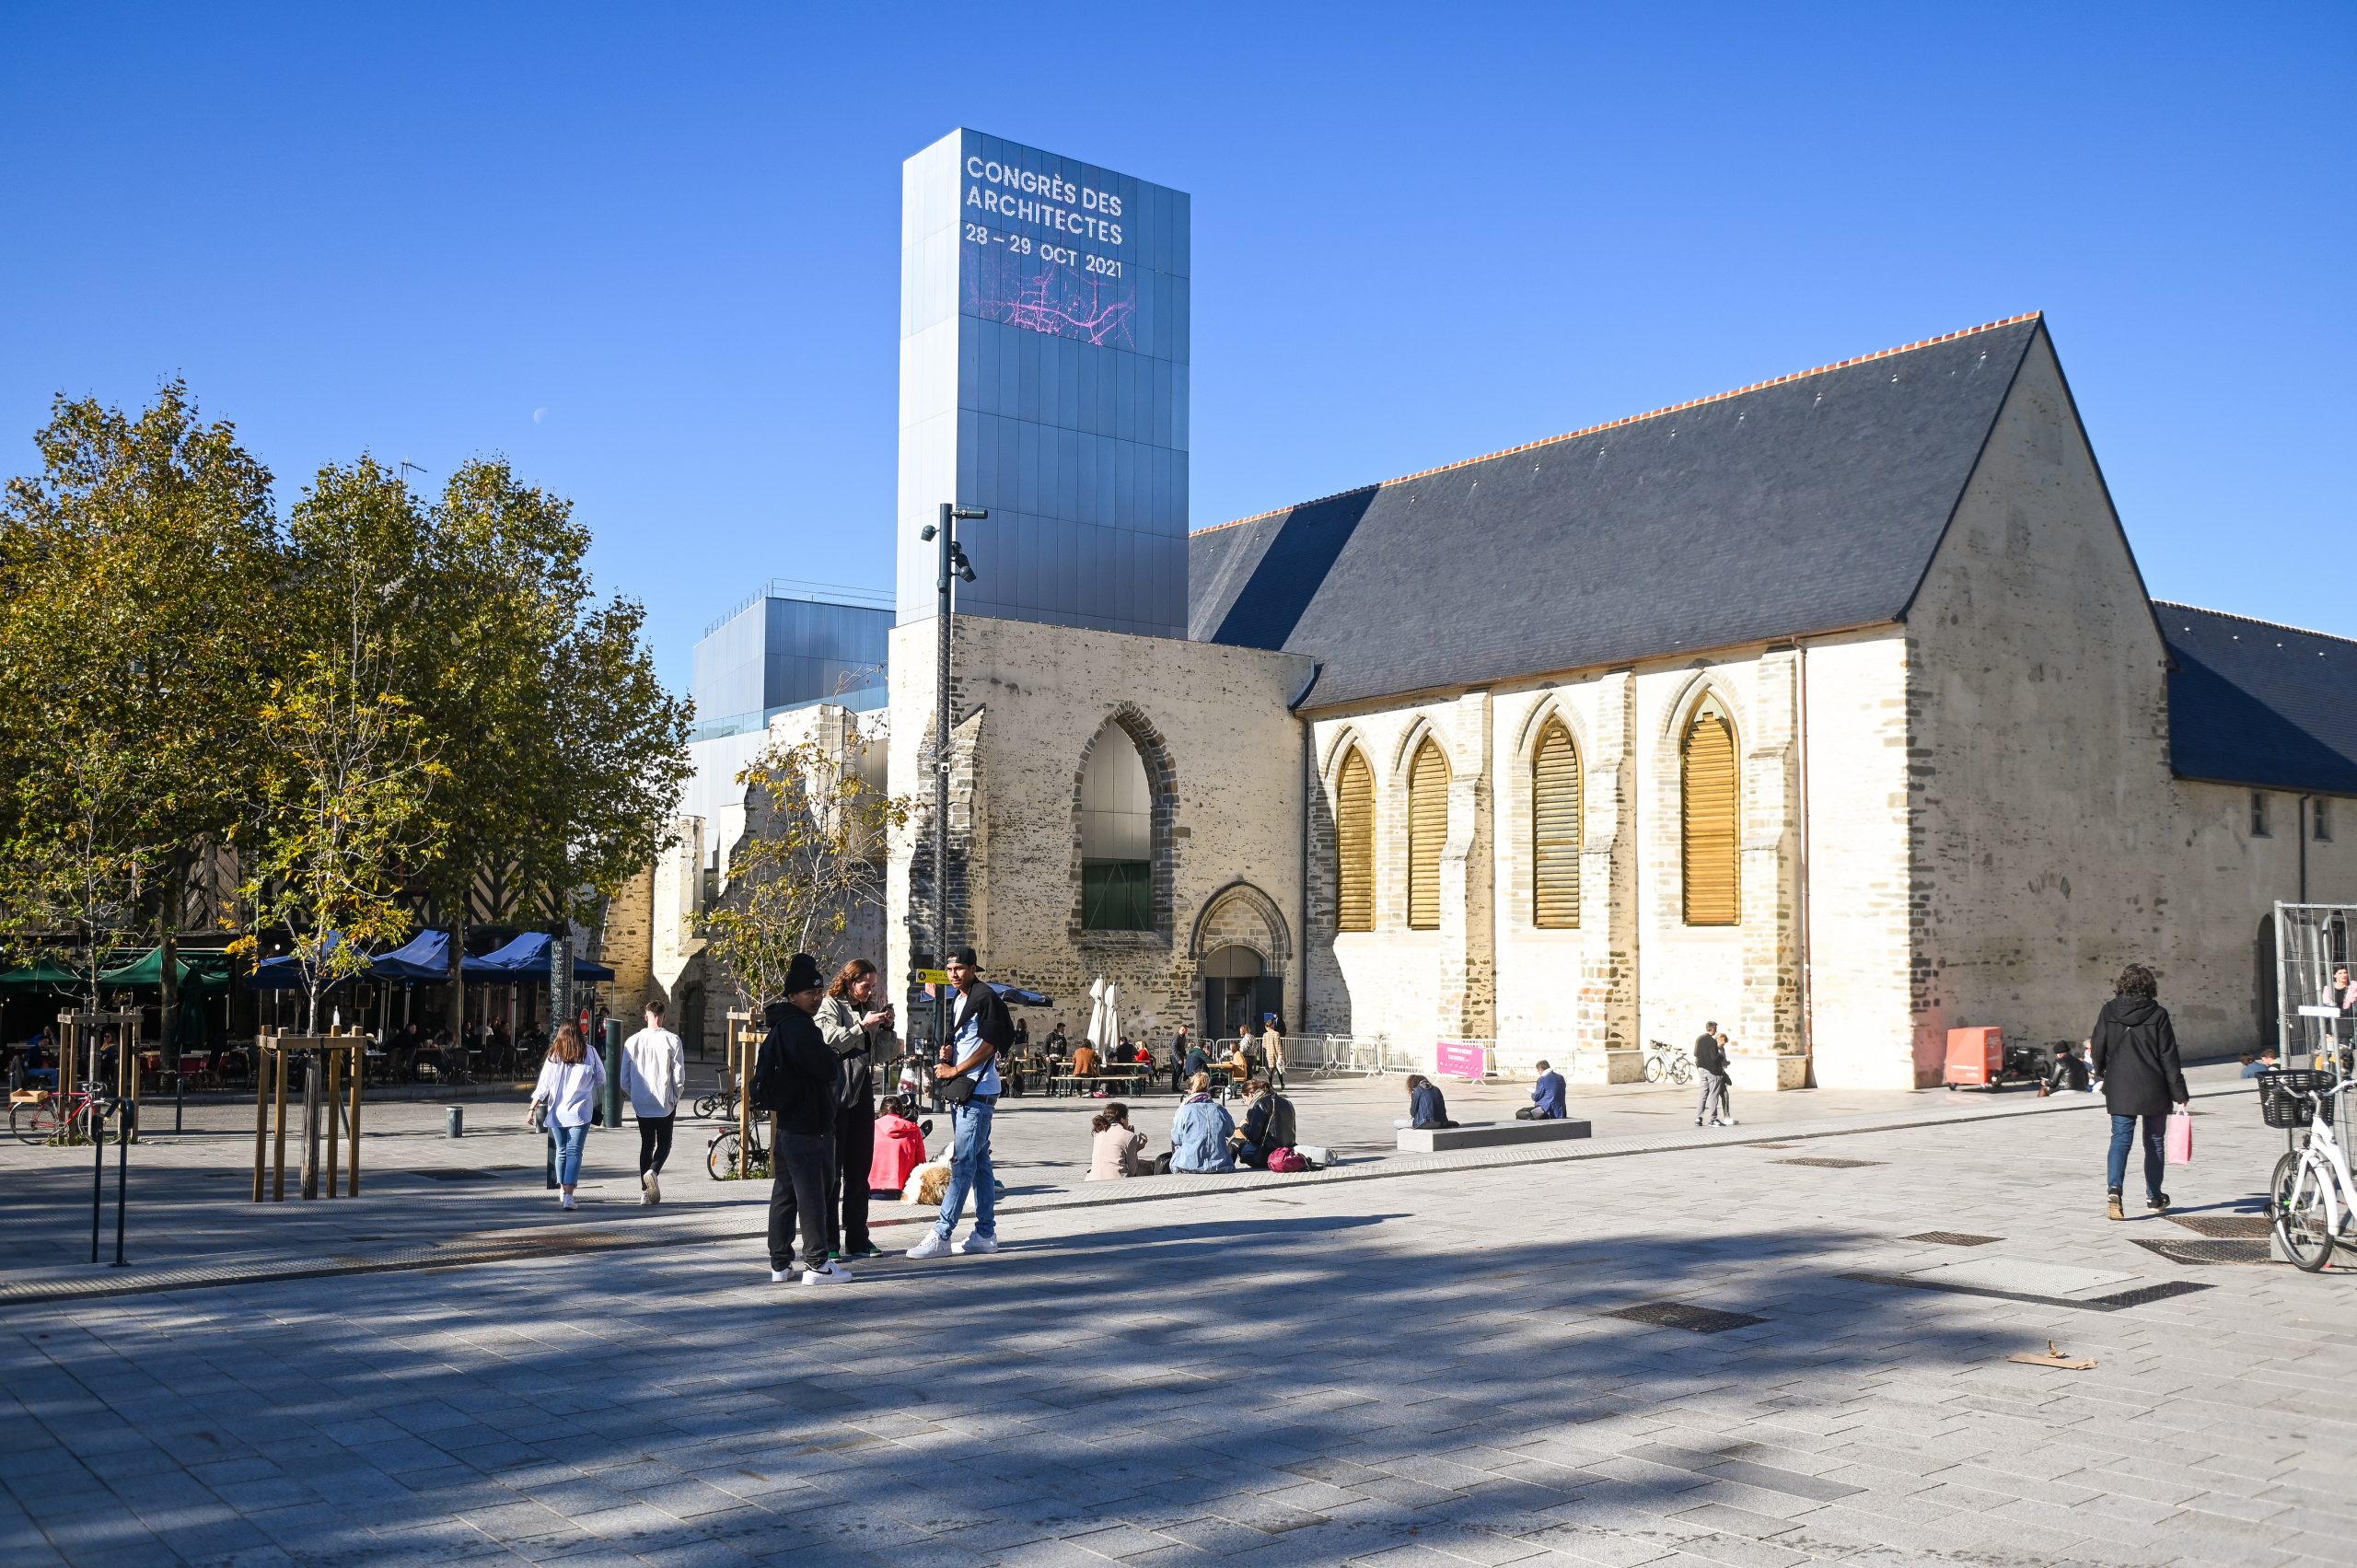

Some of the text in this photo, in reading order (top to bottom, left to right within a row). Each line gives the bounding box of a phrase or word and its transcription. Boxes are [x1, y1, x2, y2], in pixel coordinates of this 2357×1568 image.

[966, 185, 1123, 245] ARCHITECTES
[967, 156, 1122, 217] CONGRÈS DES
[966, 223, 988, 245] 28
[1009, 234, 1031, 255] 29
[1039, 244, 1077, 267] OCT
[1086, 254, 1121, 279] 2021
